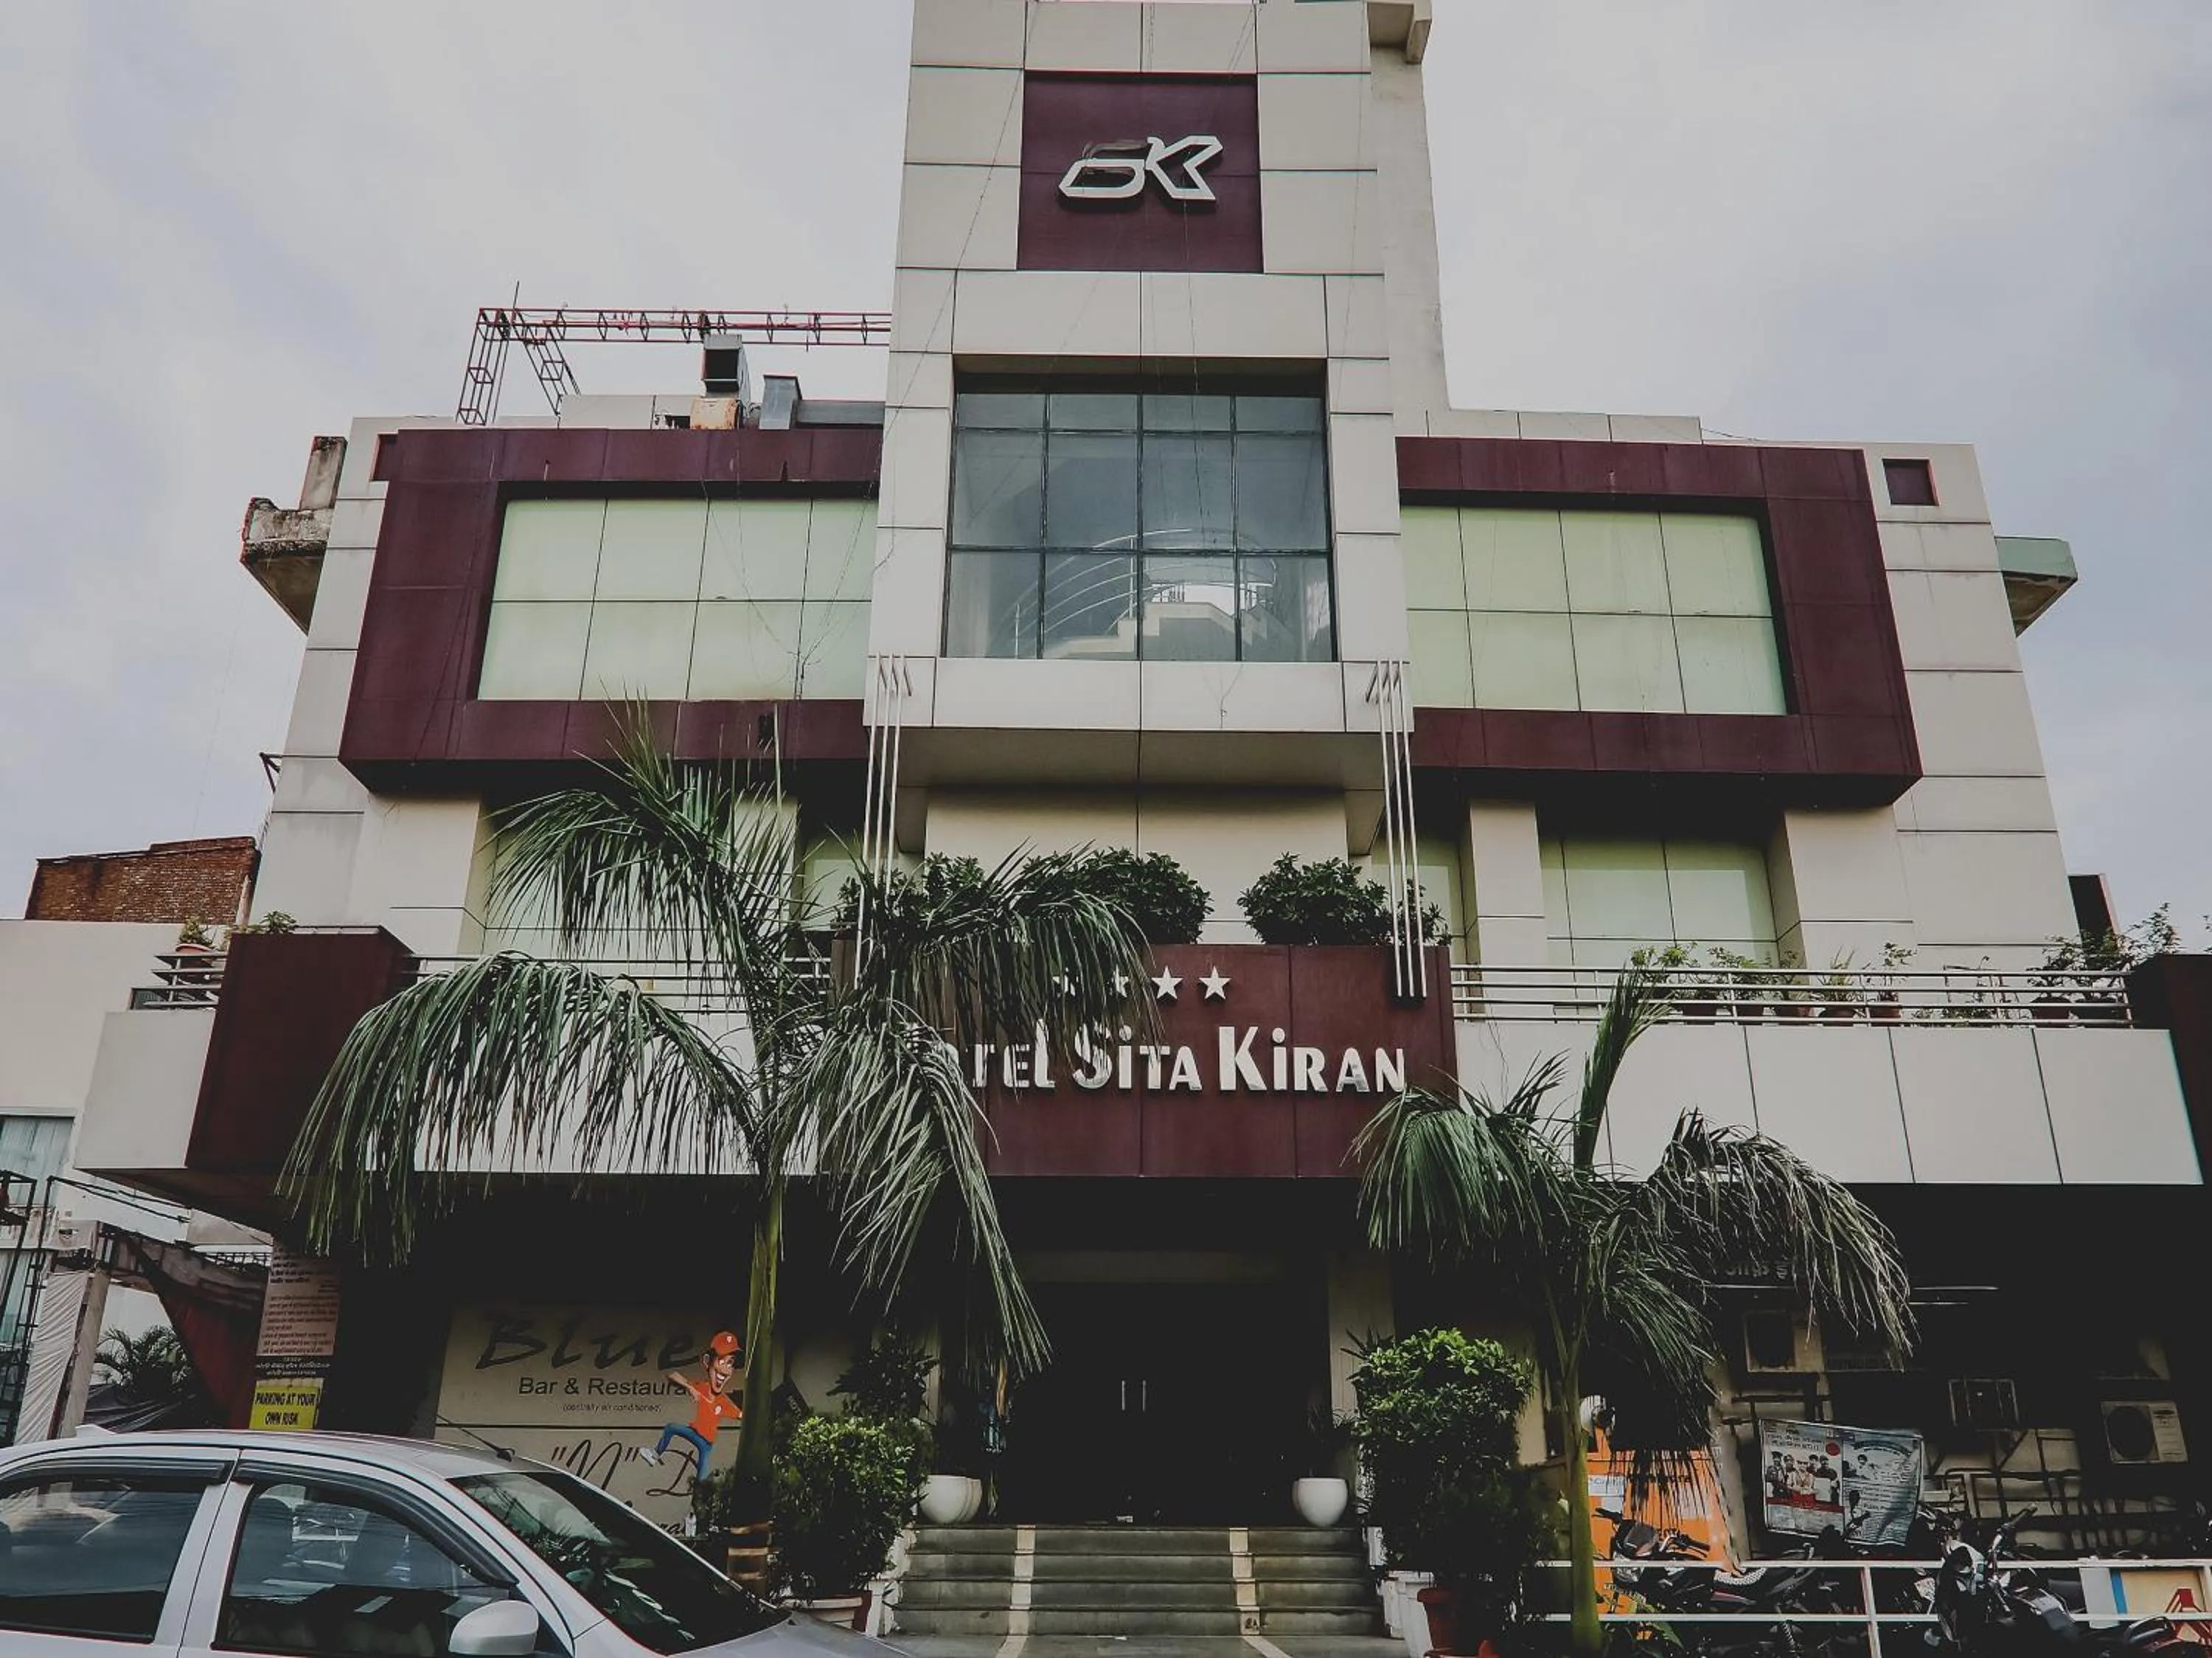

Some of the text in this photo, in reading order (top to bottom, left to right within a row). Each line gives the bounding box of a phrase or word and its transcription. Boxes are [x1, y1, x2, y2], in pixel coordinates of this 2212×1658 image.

[473, 1310, 701, 1370] Blue
[519, 1377, 694, 1395] Bar & Restaura
